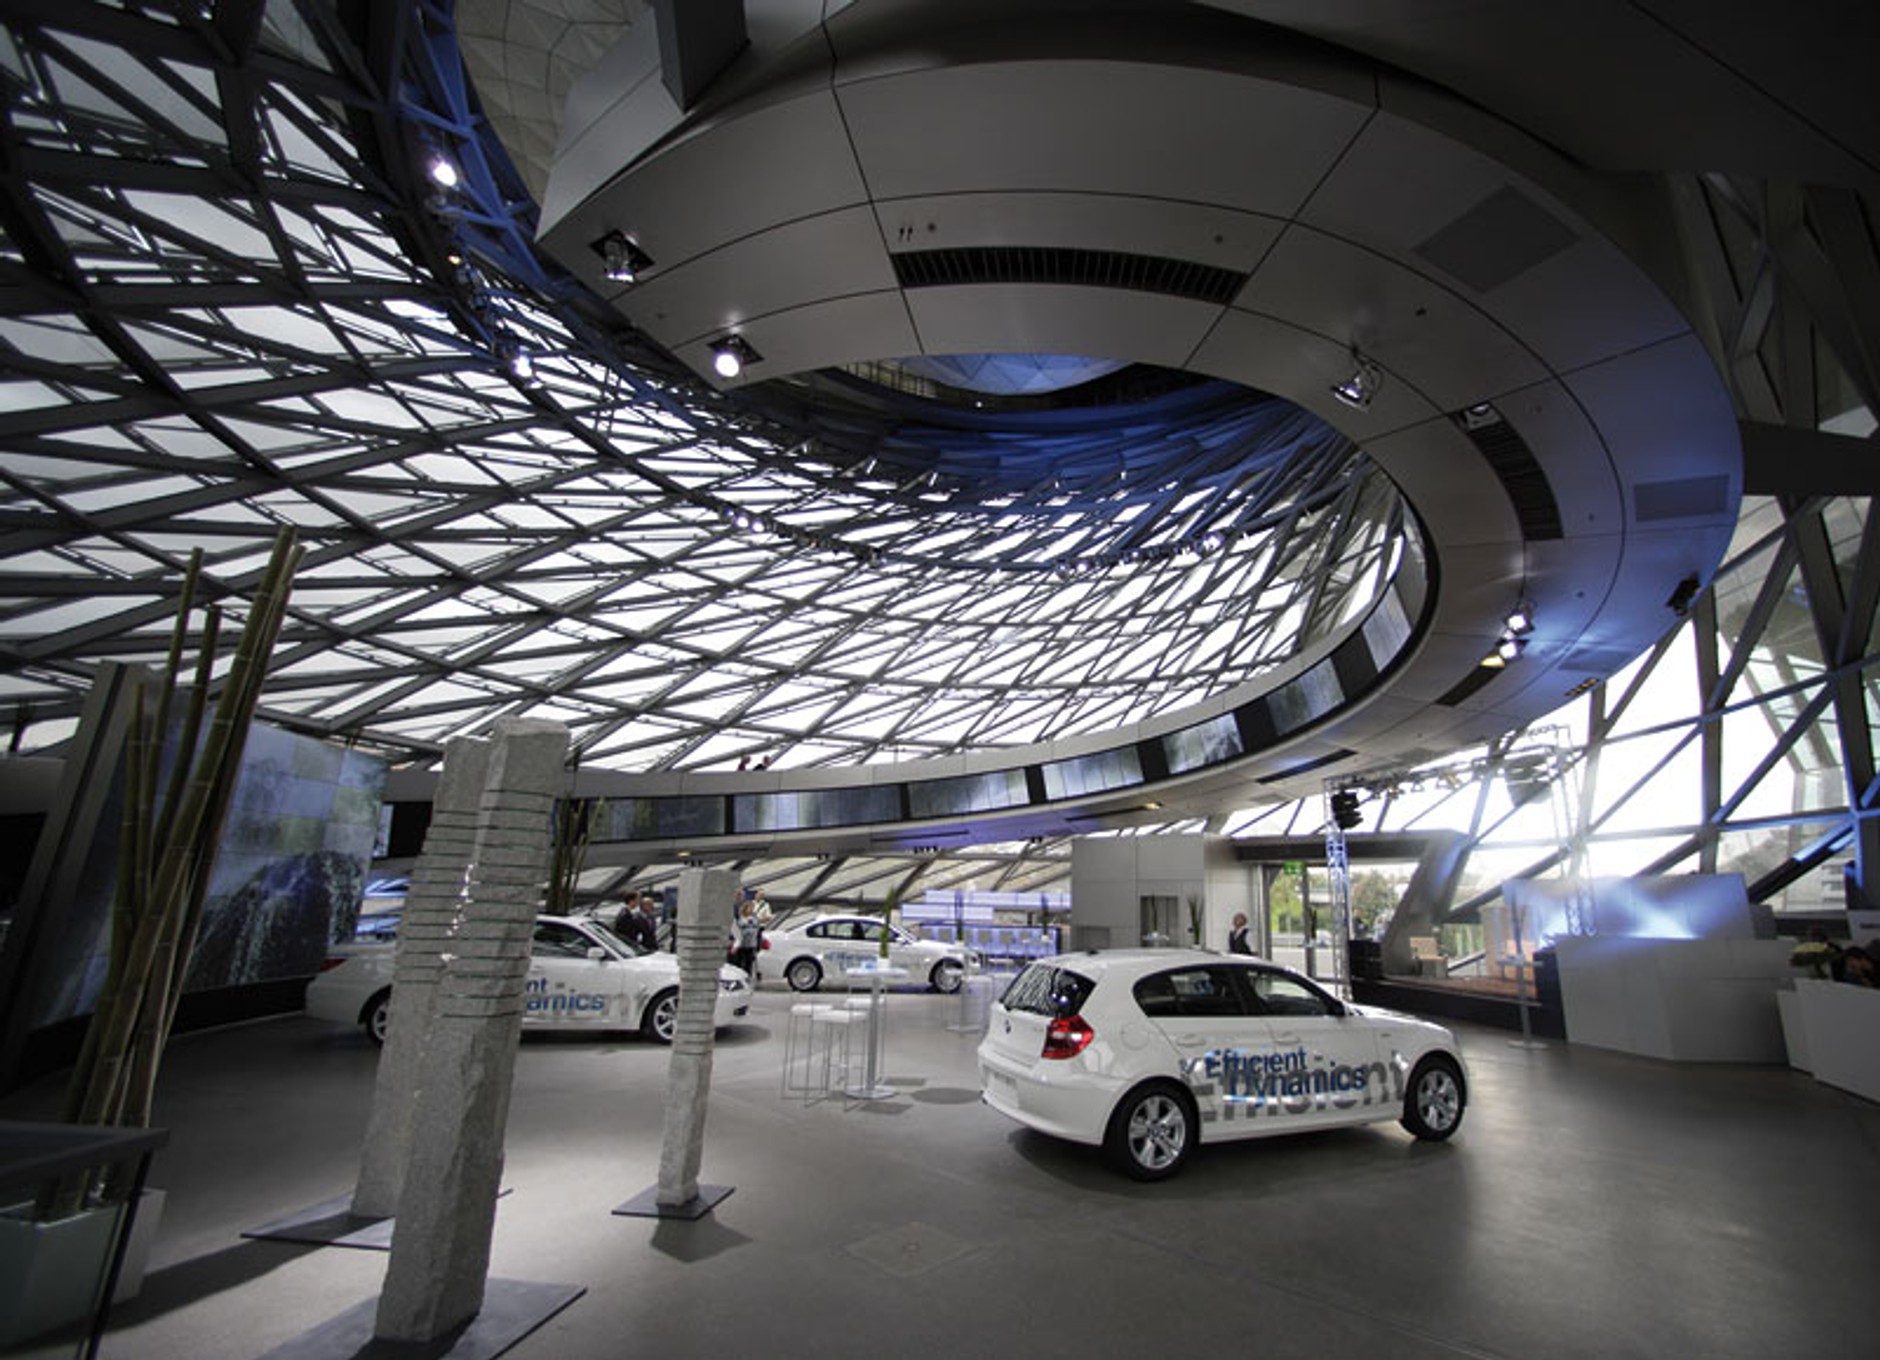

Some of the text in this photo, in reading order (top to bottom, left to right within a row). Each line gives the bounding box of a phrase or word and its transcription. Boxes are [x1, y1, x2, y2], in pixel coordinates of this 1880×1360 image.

[526, 989, 605, 1011] amics
[1204, 1046, 1308, 1079] Efficient
[1228, 1061, 1367, 1108] Dynamics
